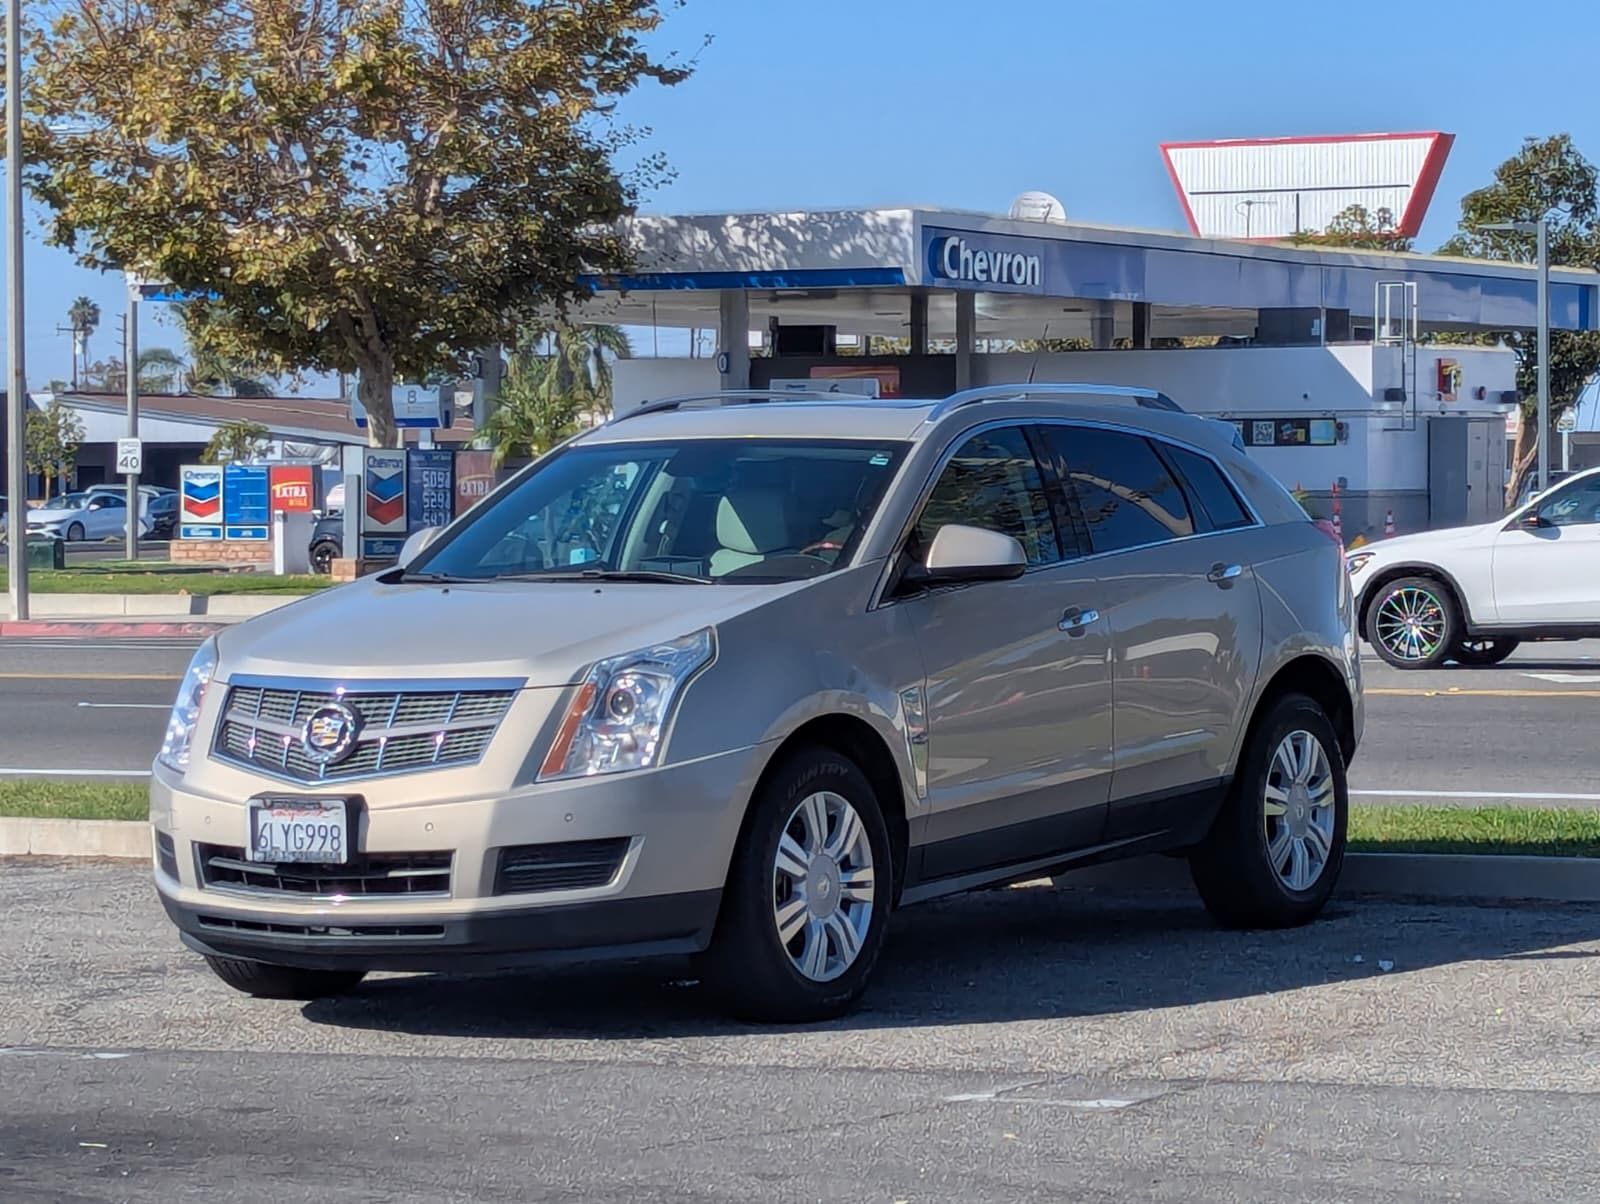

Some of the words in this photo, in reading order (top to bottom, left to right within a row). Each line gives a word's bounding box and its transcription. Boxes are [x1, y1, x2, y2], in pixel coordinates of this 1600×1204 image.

[943, 236, 1040, 285] Chevron
[120, 456, 139, 469] 40
[367, 455, 402, 469] Chevron
[183, 470, 220, 480] Chevron
[275, 485, 308, 498] EXTRA
[258, 821, 341, 852] 6LYG998
